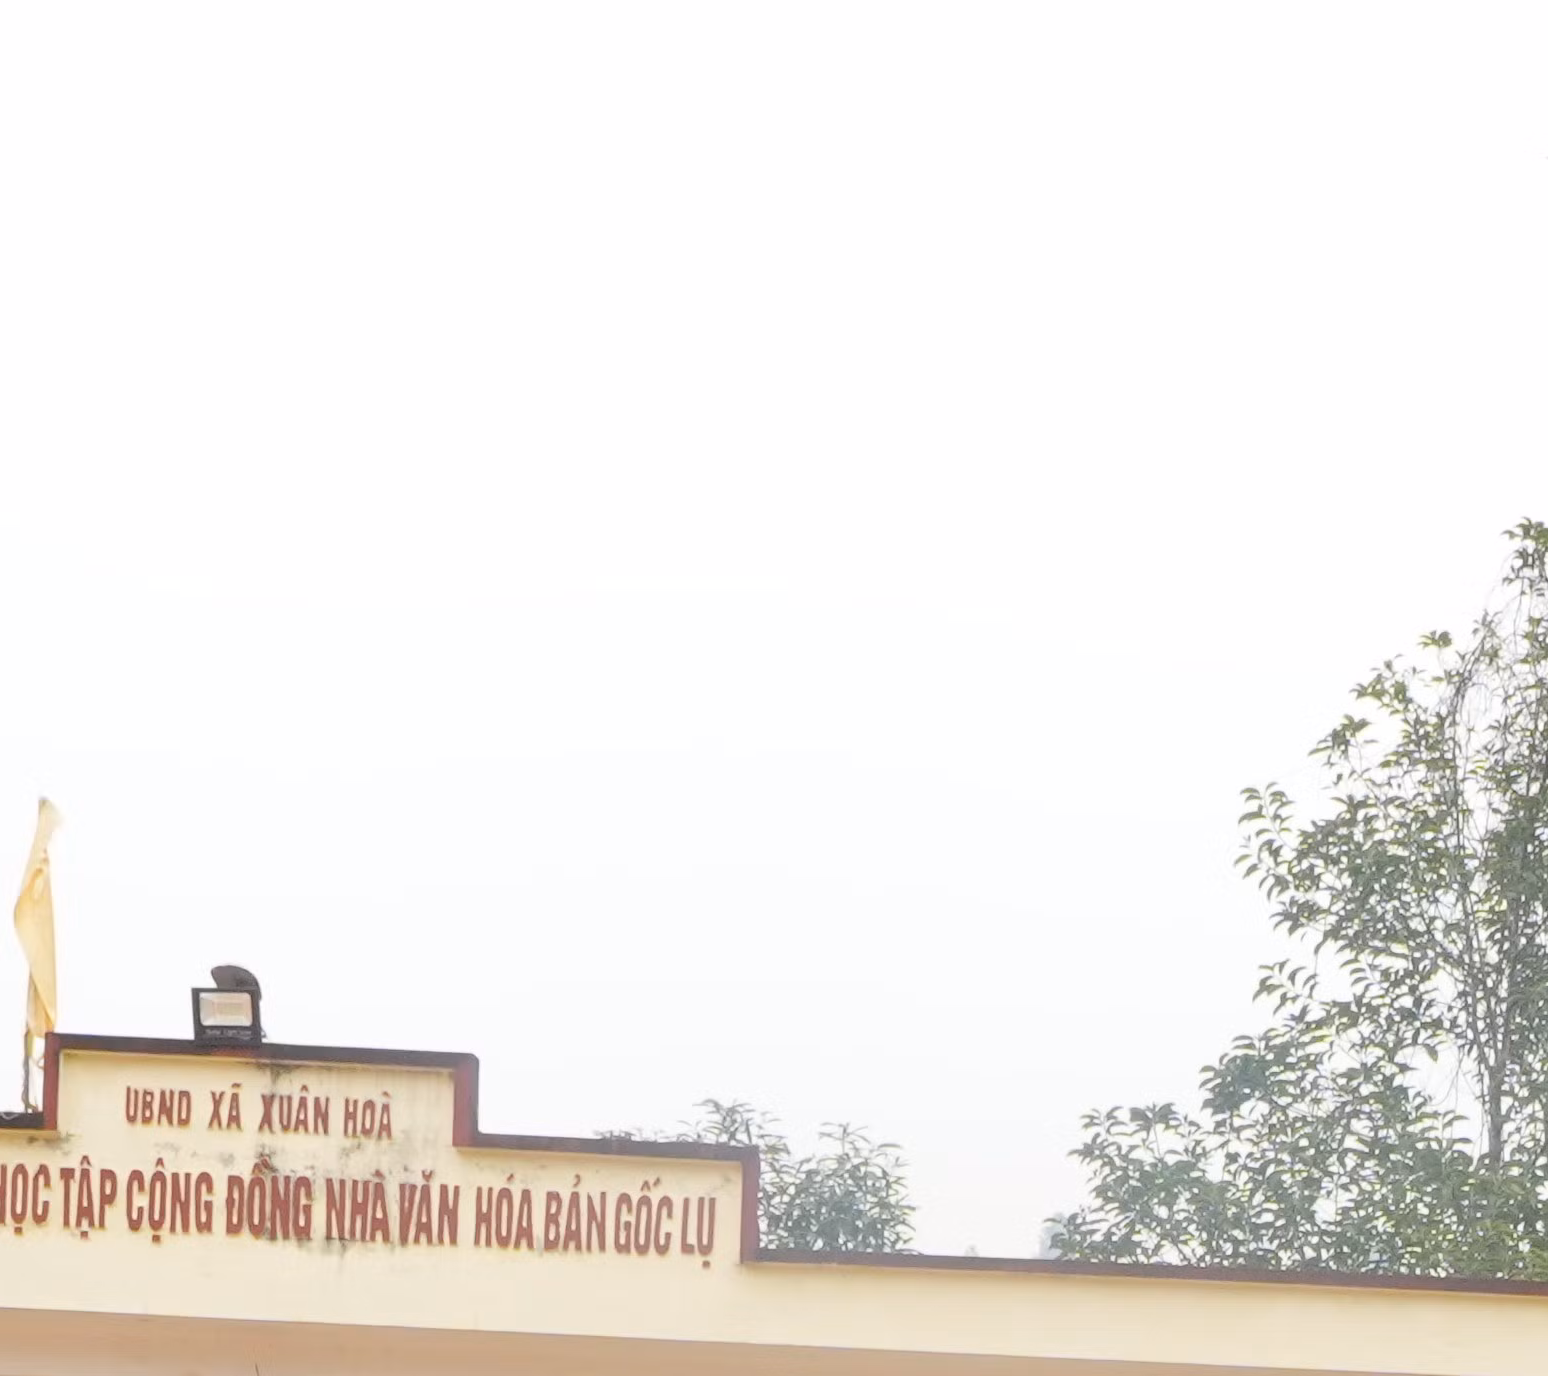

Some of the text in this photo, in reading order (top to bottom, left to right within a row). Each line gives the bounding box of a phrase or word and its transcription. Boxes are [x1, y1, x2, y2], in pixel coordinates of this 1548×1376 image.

[125, 1083, 393, 1140] UBND XÃ XUÂN HOÀ
[60, 1155, 118, 1240] TẬP
[126, 1157, 214, 1243] CỘNG
[225, 1156, 313, 1242] ĐỒNG
[325, 1169, 390, 1244] NHÀ
[399, 1169, 460, 1247] VĂN
[474, 1173, 535, 1250] HÓA
[544, 1174, 607, 1253] BẢN
[614, 1177, 674, 1255] GỐC
[680, 1196, 717, 1269] LỤ
